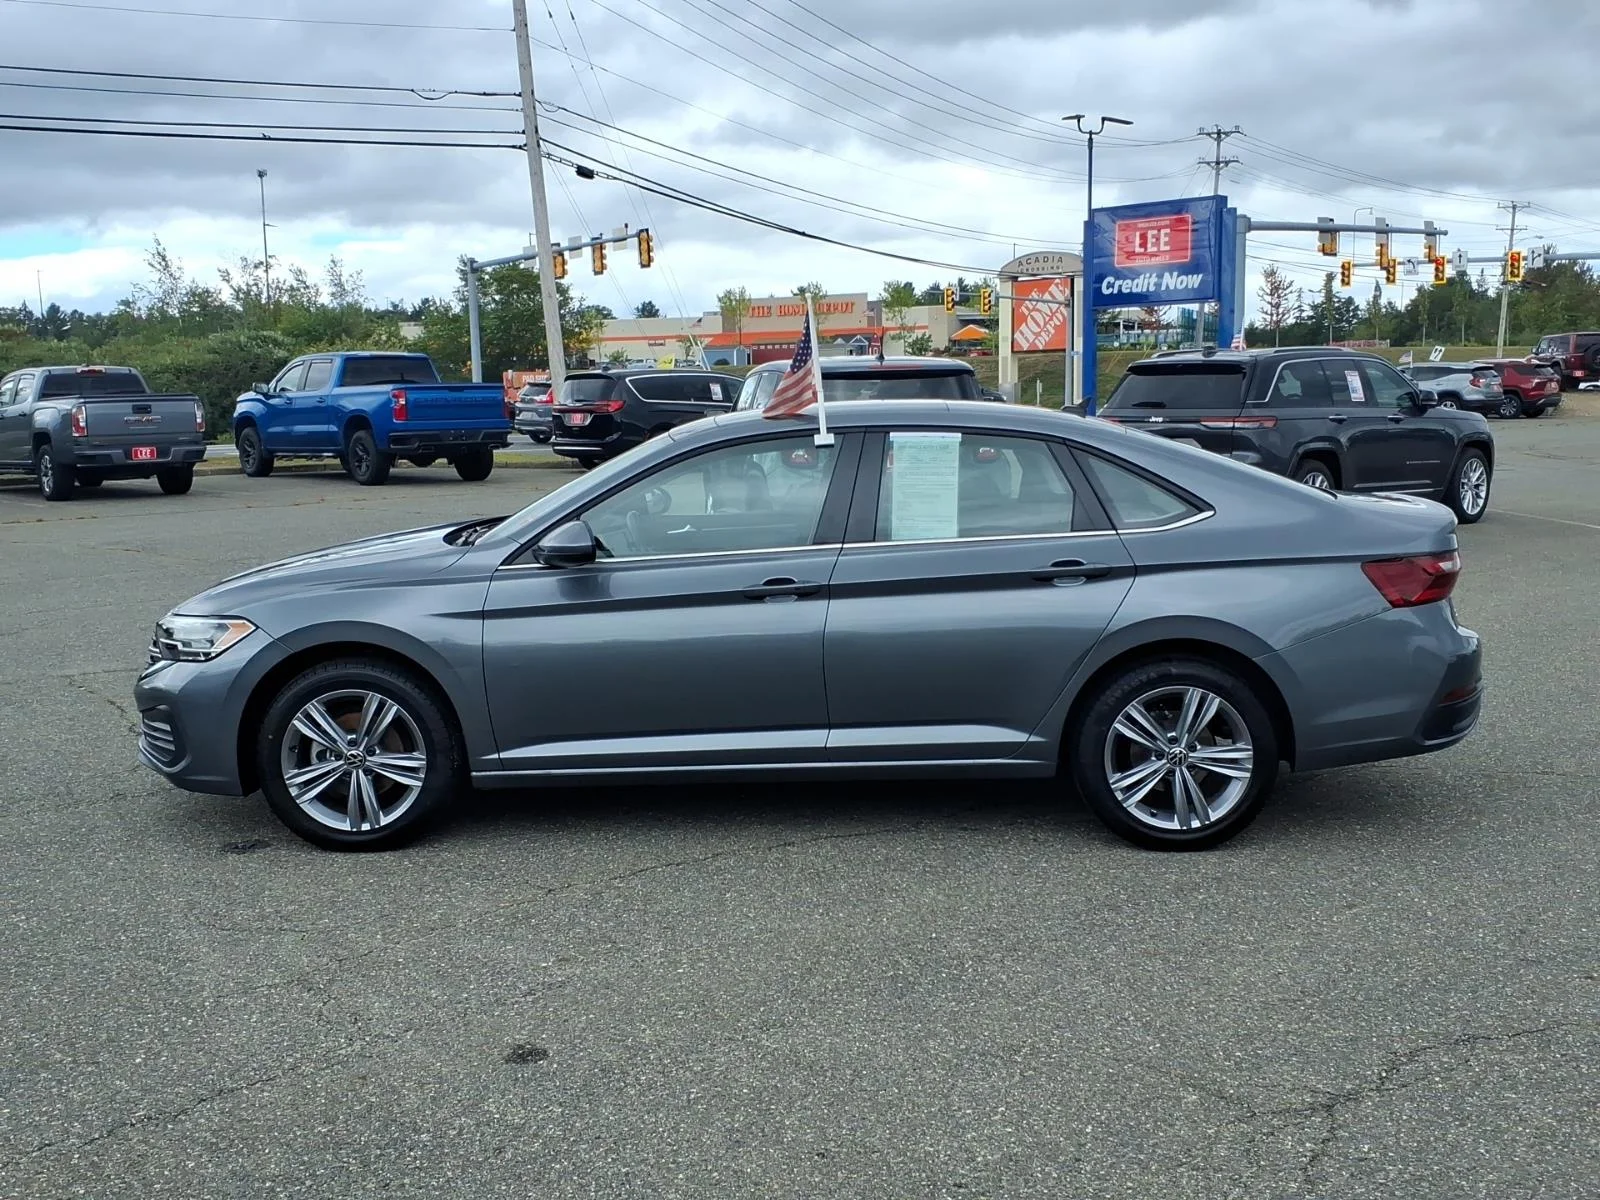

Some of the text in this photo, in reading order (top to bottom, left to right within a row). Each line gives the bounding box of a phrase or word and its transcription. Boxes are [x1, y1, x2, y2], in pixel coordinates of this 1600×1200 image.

[1134, 228, 1171, 253] LEE
[1017, 255, 1064, 268] ACADIA
[1101, 271, 1203, 295] Credit Now
[750, 305, 772, 317] THE
[1013, 278, 1069, 351] HOME
[137, 449, 152, 458] LEE
